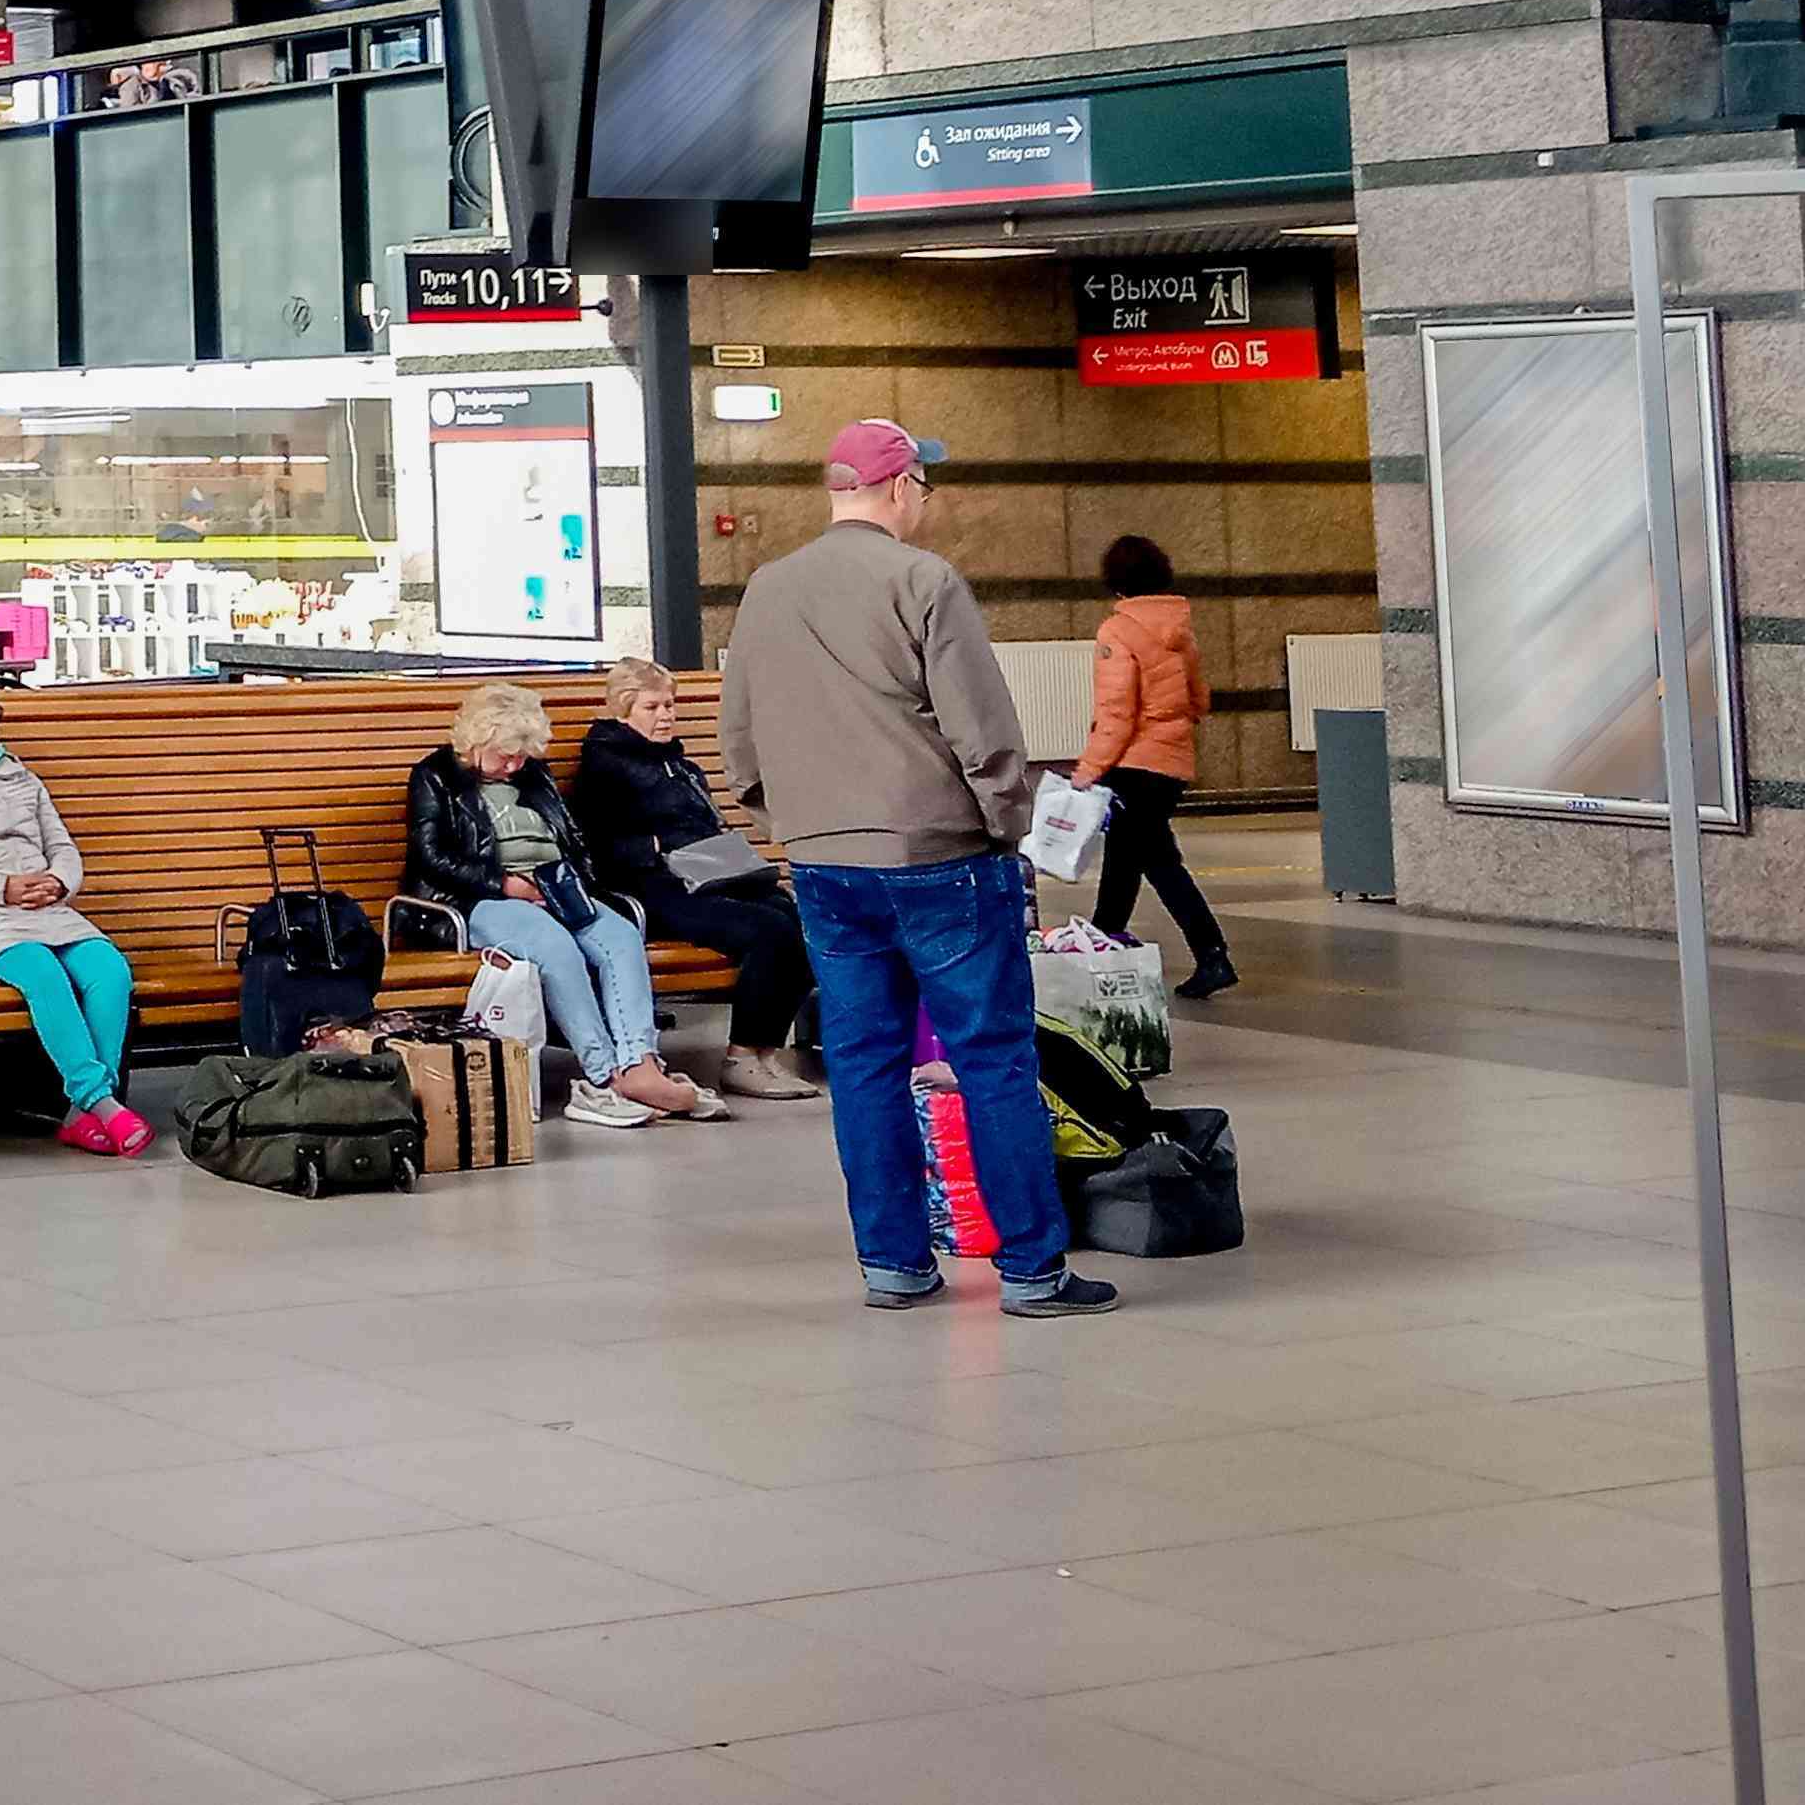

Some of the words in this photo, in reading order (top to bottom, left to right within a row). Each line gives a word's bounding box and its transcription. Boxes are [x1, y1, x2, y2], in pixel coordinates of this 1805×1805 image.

[945, 126, 971, 143] Зал
[974, 121, 1050, 142] ожидания
[420, 269, 458, 290] Пути
[461, 268, 546, 310] 10,11
[1110, 274, 1198, 302] Выход
[423, 292, 458, 305] Tracks
[1113, 307, 1150, 329] Exit
